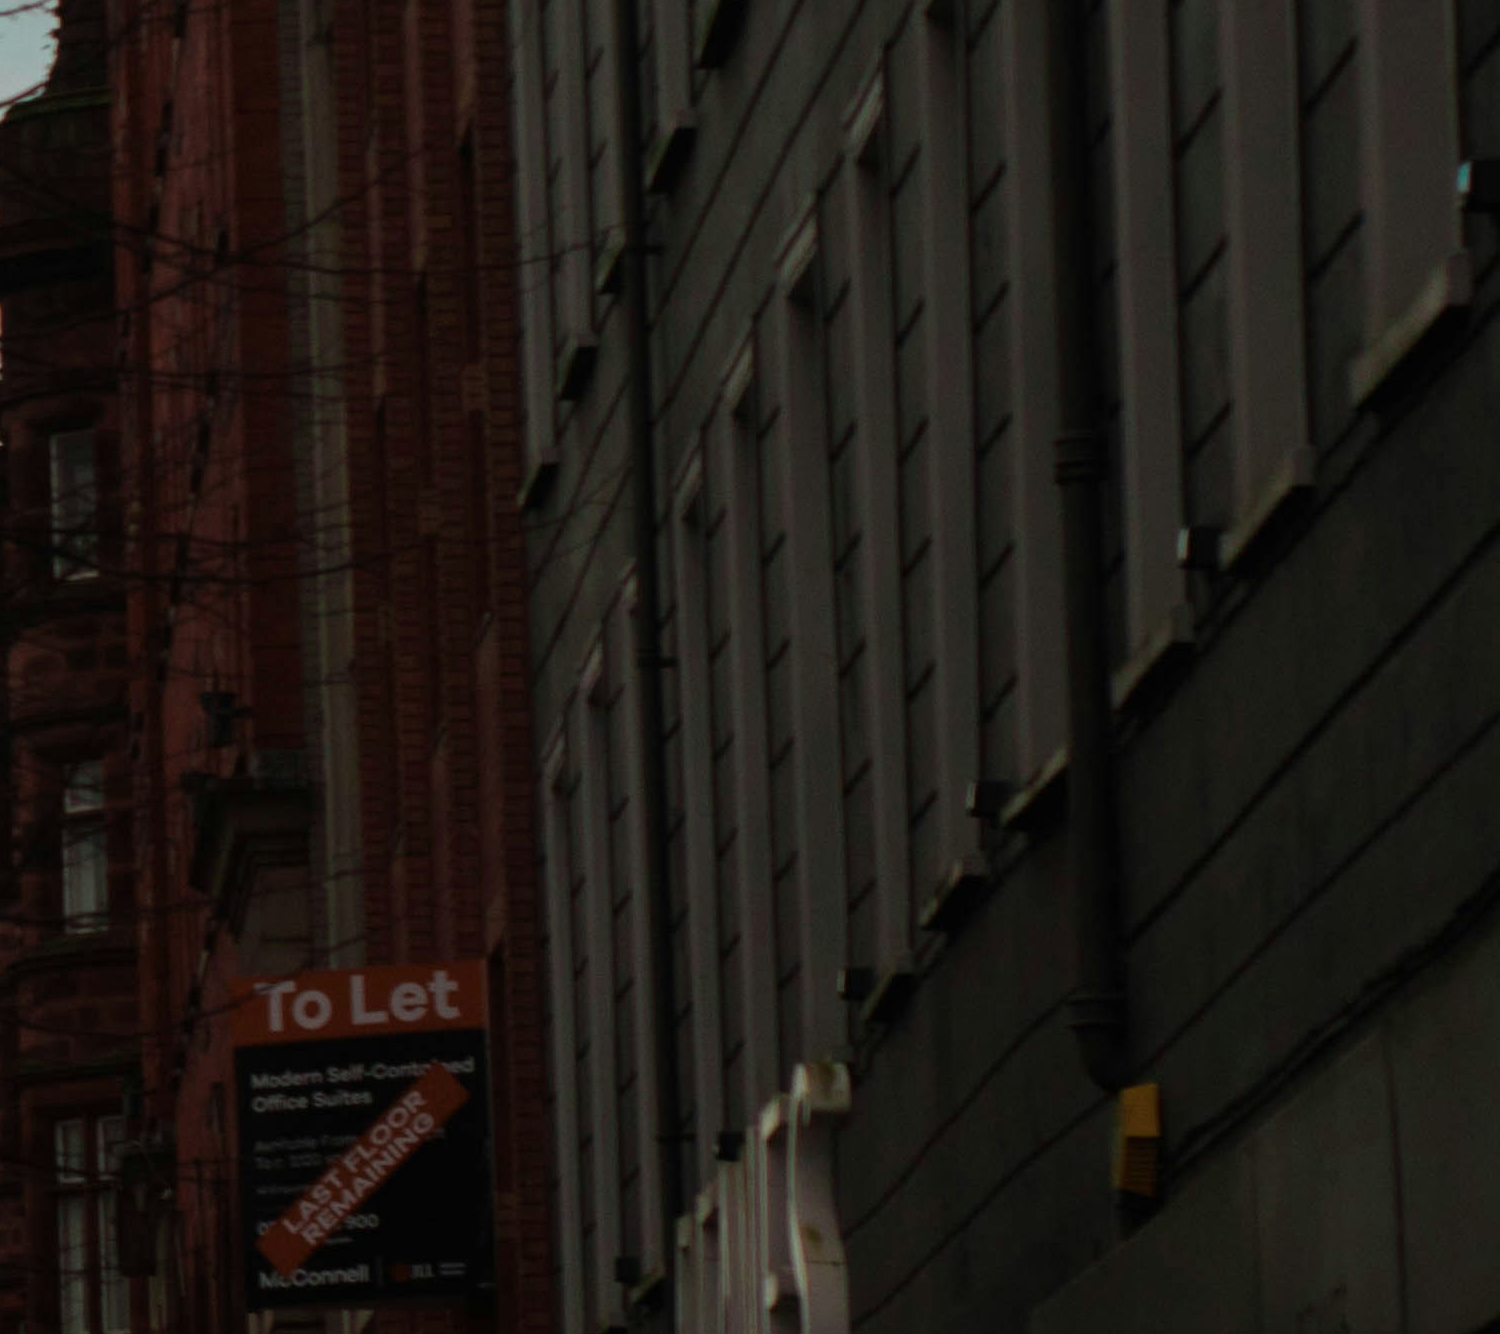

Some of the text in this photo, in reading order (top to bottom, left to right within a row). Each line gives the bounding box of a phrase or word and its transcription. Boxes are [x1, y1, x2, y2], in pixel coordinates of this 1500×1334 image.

[252, 969, 462, 1033] To Let
[251, 1069, 325, 1090] Modern
[251, 1093, 310, 1114] Office
[281, 1090, 428, 1235] LAST FLOOR
[300, 1112, 435, 1246] REMAINING
